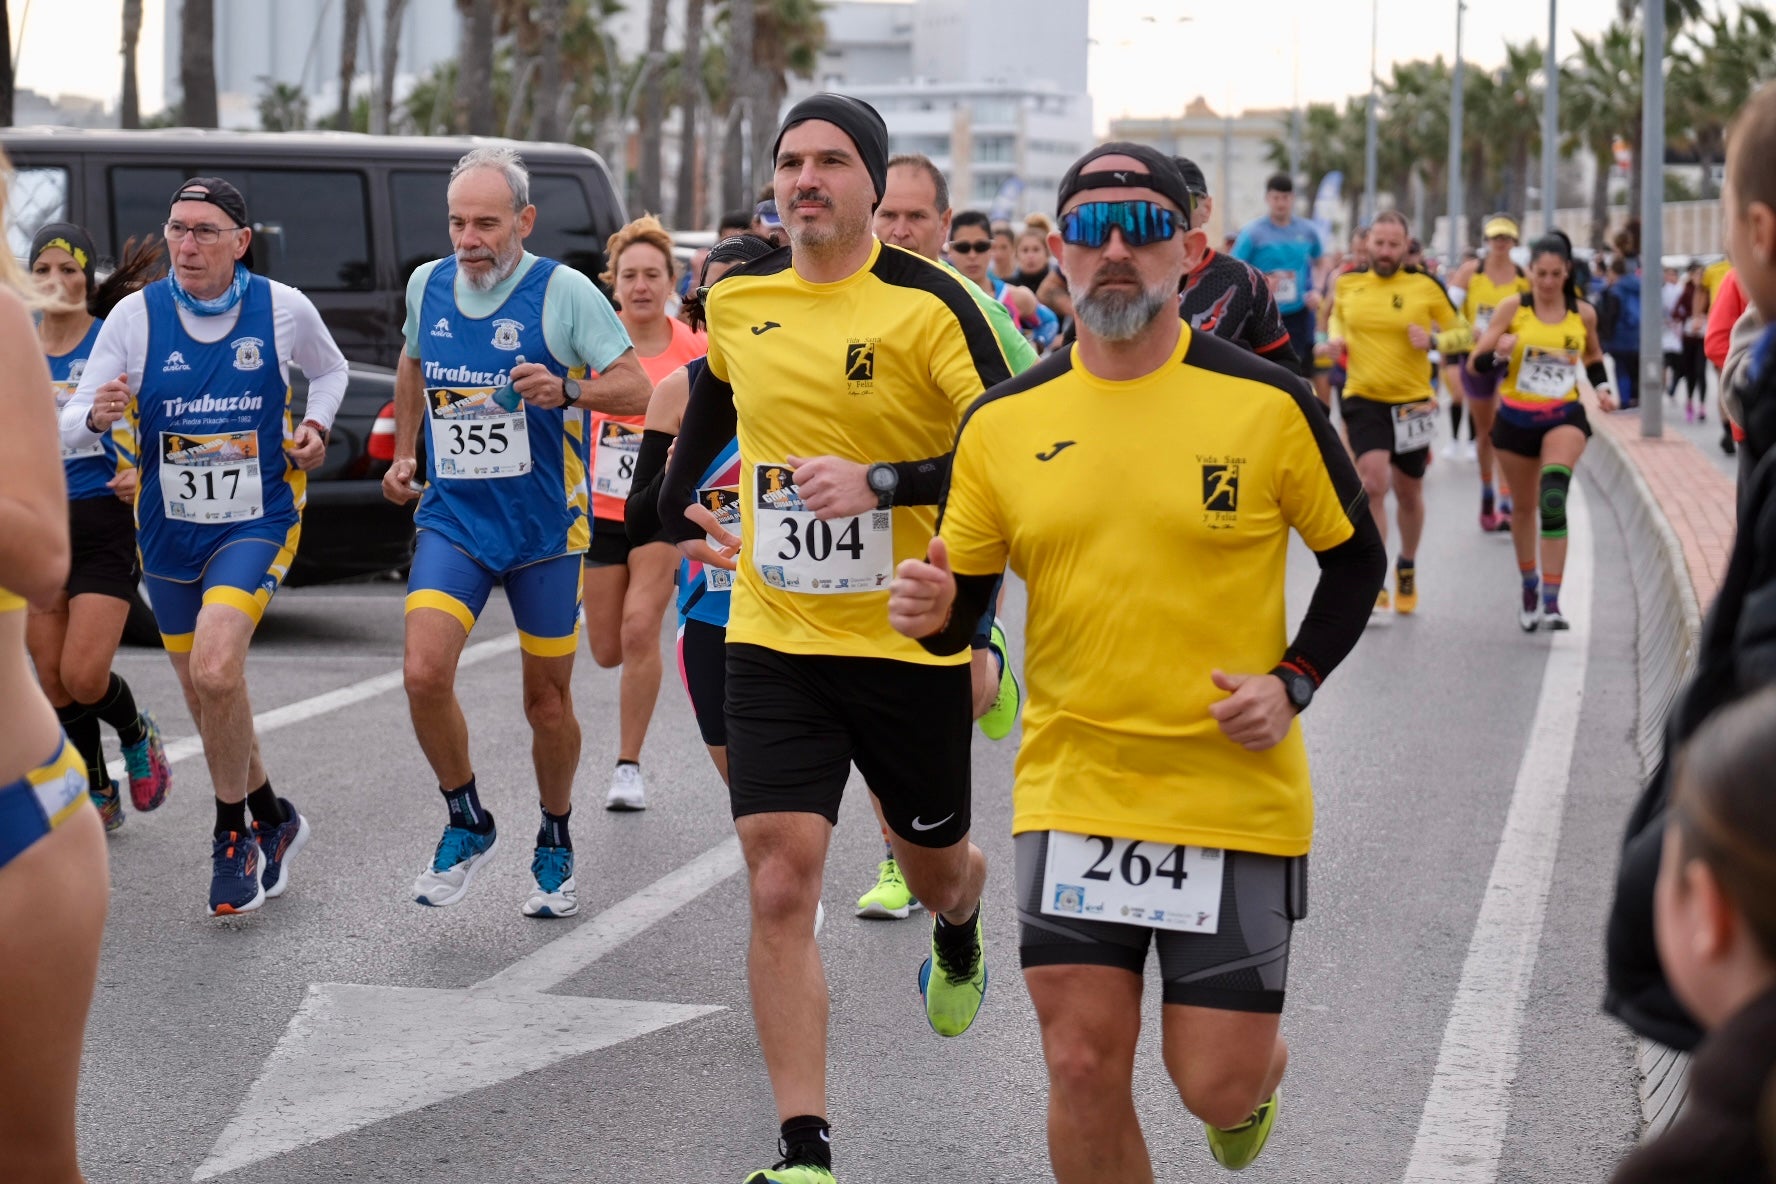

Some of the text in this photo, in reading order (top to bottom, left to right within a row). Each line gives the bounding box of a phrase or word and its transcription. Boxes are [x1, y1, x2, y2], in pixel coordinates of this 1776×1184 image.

[163, 391, 262, 417] Tirabuzón
[448, 422, 509, 455] 355
[179, 469, 240, 500] 317
[778, 517, 864, 562] 304
[1081, 834, 1188, 889] 264
